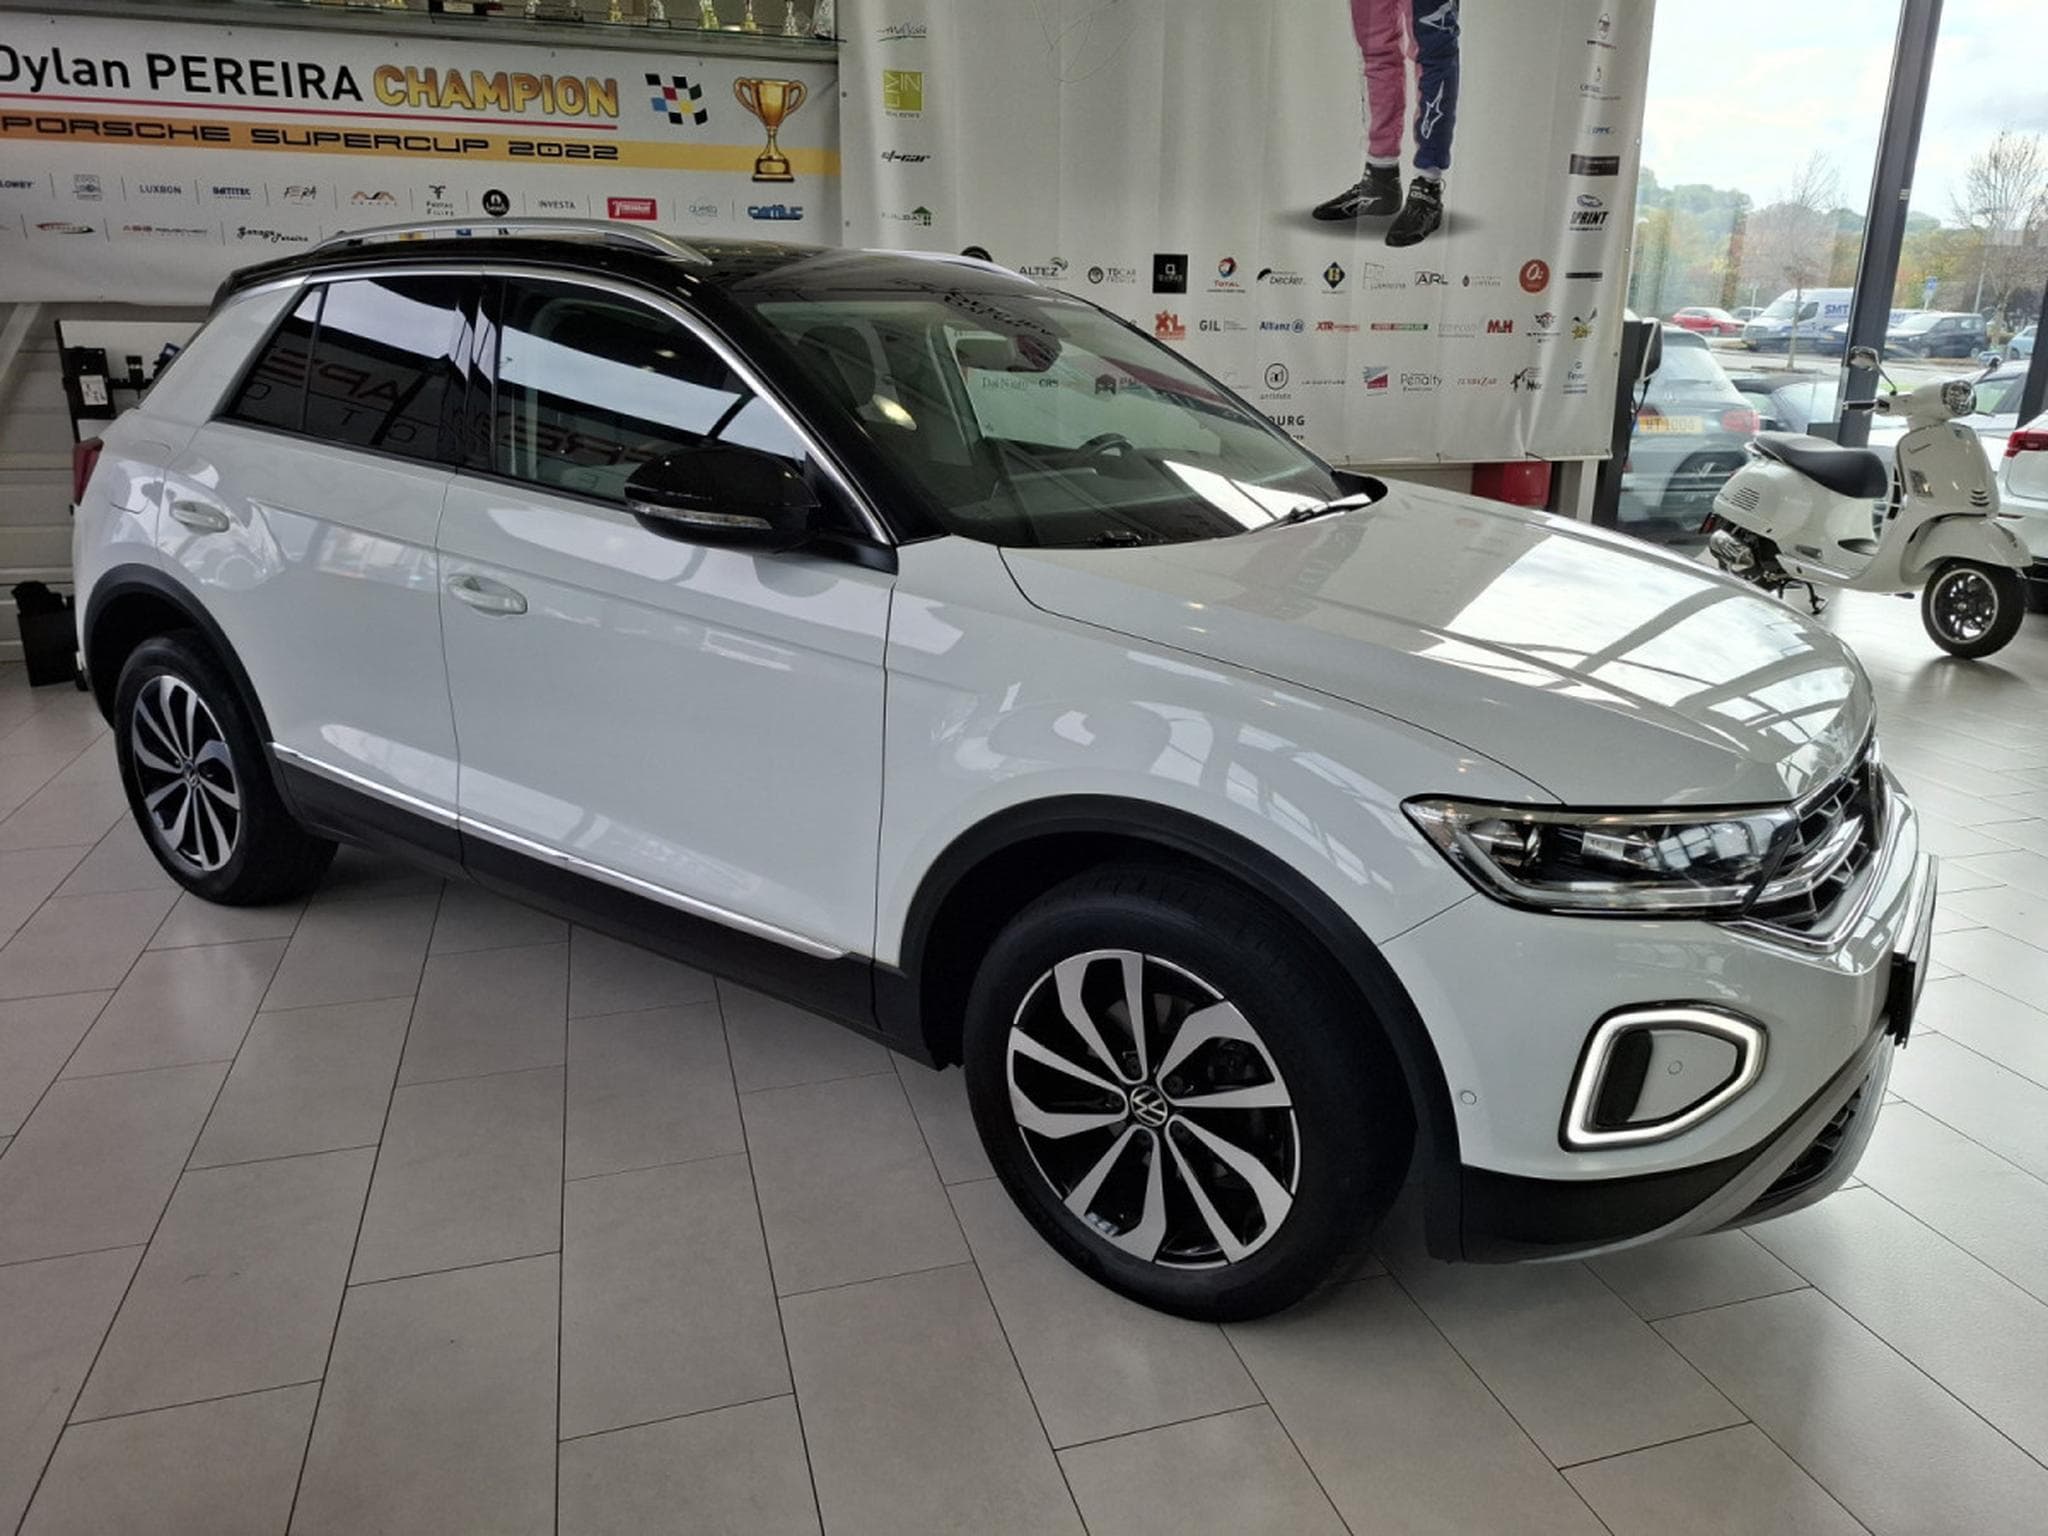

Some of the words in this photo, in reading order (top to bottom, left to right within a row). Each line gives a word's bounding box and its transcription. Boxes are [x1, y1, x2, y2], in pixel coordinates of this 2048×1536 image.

[0, 44, 130, 93] Dylan
[145, 52, 364, 101] PEREIRA
[373, 64, 620, 118] CHAMPION
[1, 116, 231, 142] PORSCHE
[250, 128, 489, 154] SUPERCUP
[507, 139, 618, 160] 2022
[538, 199, 576, 210] INVESTA
[1018, 266, 1059, 277] ALTEZ
[1199, 319, 1221, 332] GIL
[1259, 320, 1290, 331] Allianz
[1400, 373, 1443, 387] Penalty
